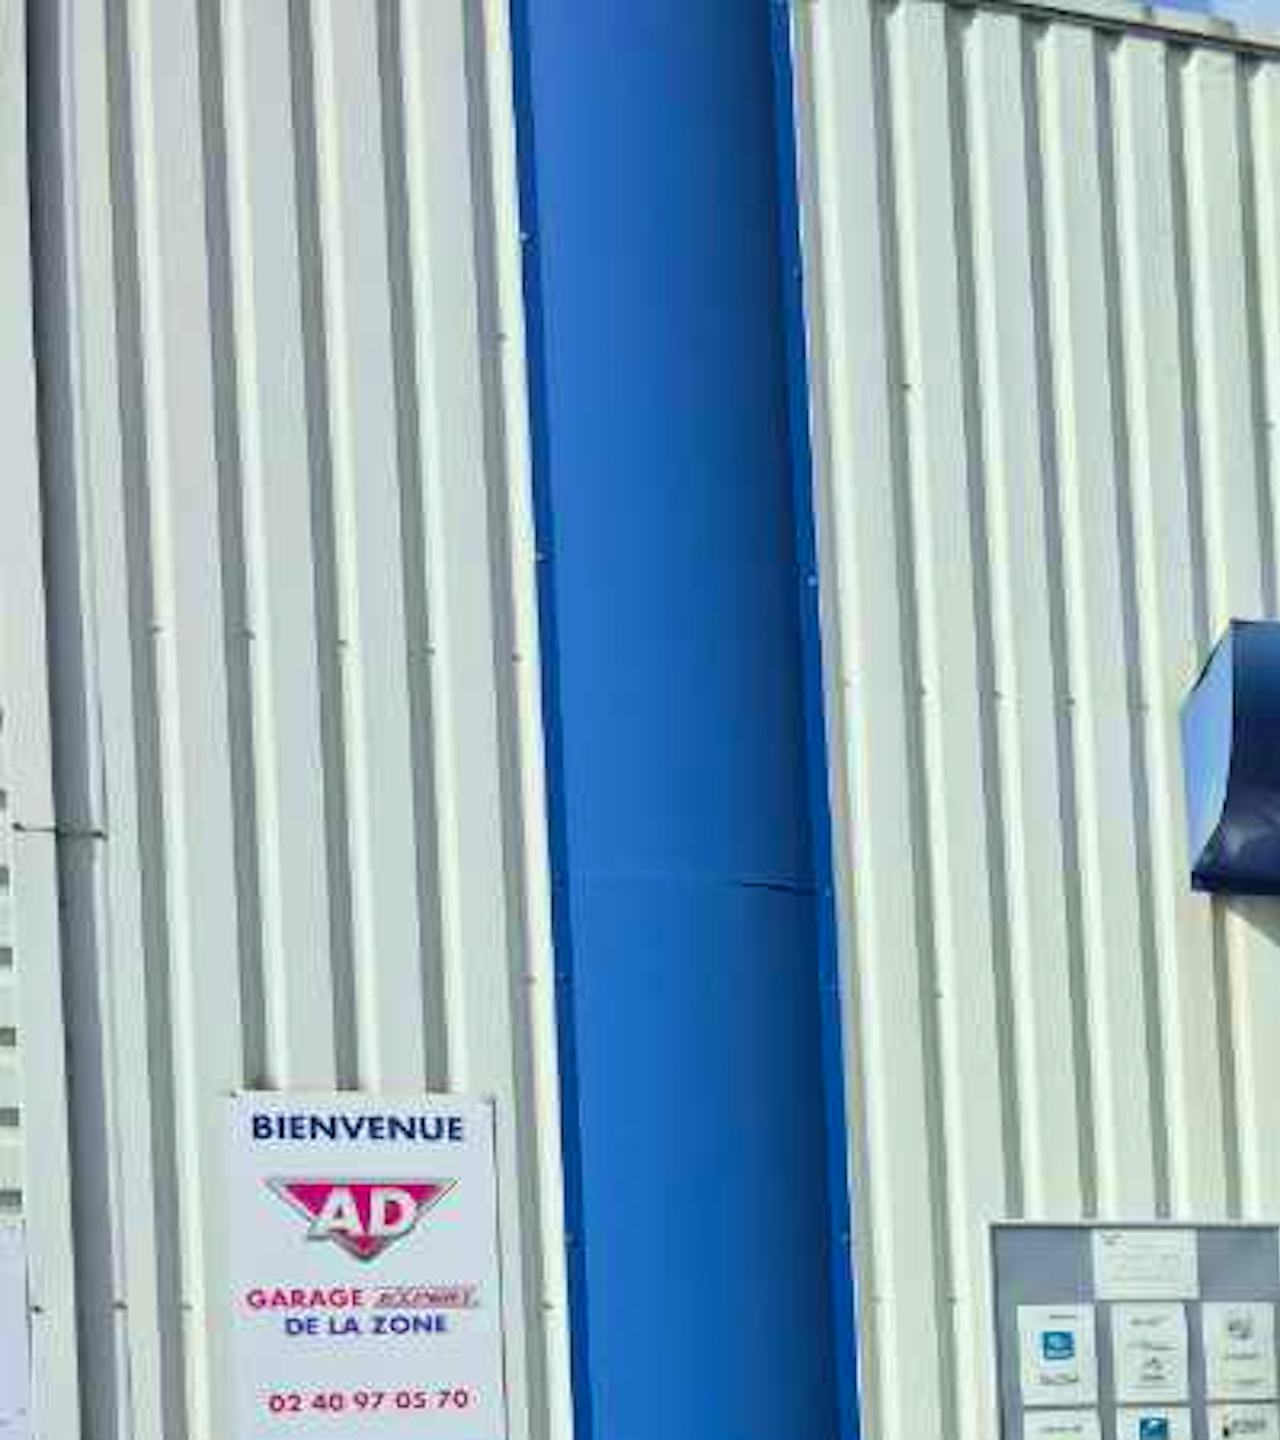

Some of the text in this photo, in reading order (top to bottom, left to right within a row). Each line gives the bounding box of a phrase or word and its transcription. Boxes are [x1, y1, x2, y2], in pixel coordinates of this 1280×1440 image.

[251, 1114, 464, 1142] BIENVENUE
[308, 1186, 418, 1238] AD
[246, 1288, 363, 1310] GARAGE
[284, 1313, 448, 1336] DE LA ZONE
[268, 1388, 469, 1413] 02 40 97 05 70
